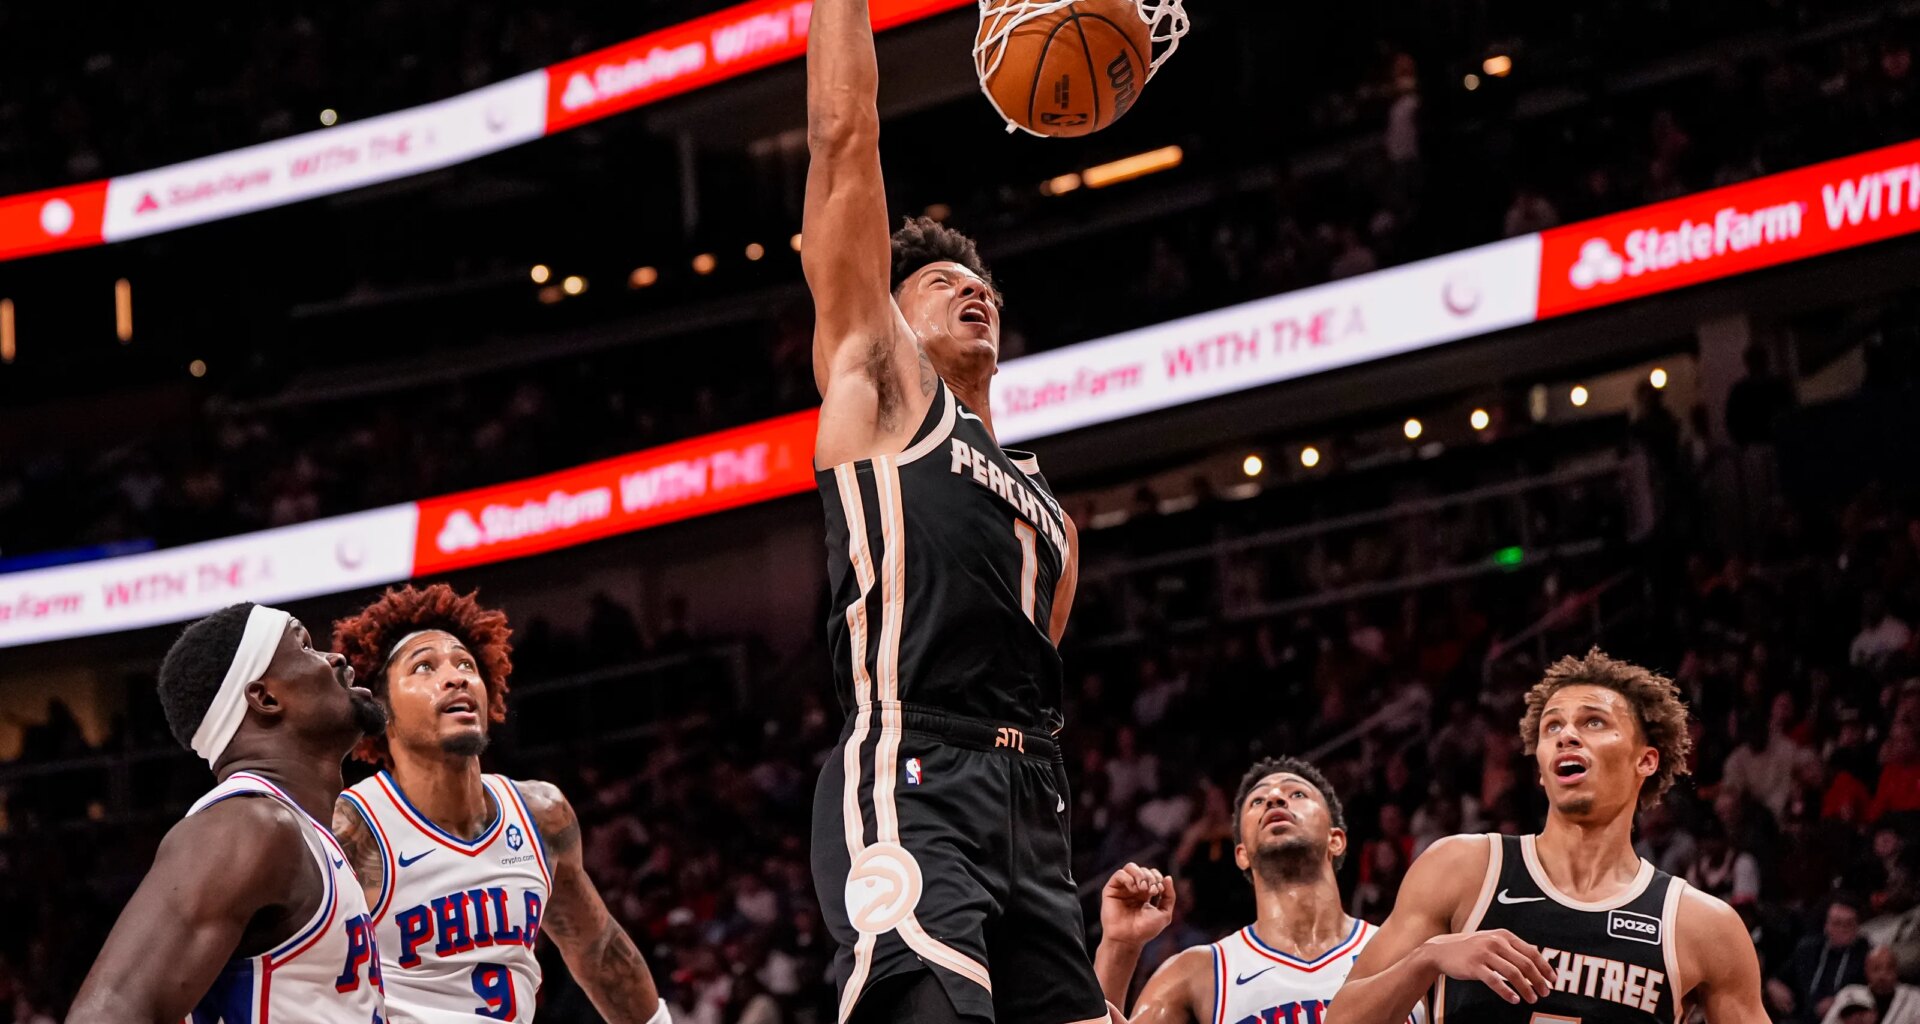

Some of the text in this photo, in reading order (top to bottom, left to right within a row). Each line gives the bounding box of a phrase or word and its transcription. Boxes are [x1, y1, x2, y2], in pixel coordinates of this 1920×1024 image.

[1107, 48, 1137, 119] Wil
[1164, 329, 1259, 379] WITH
[951, 437, 1069, 575] PEACHTR
[1014, 517, 1037, 625] 1
[995, 727, 1024, 754] ATL
[501, 853, 535, 866] crypto.com
[395, 887, 542, 969] PHILA
[1613, 917, 1657, 935] paze
[471, 962, 517, 1023] 9
